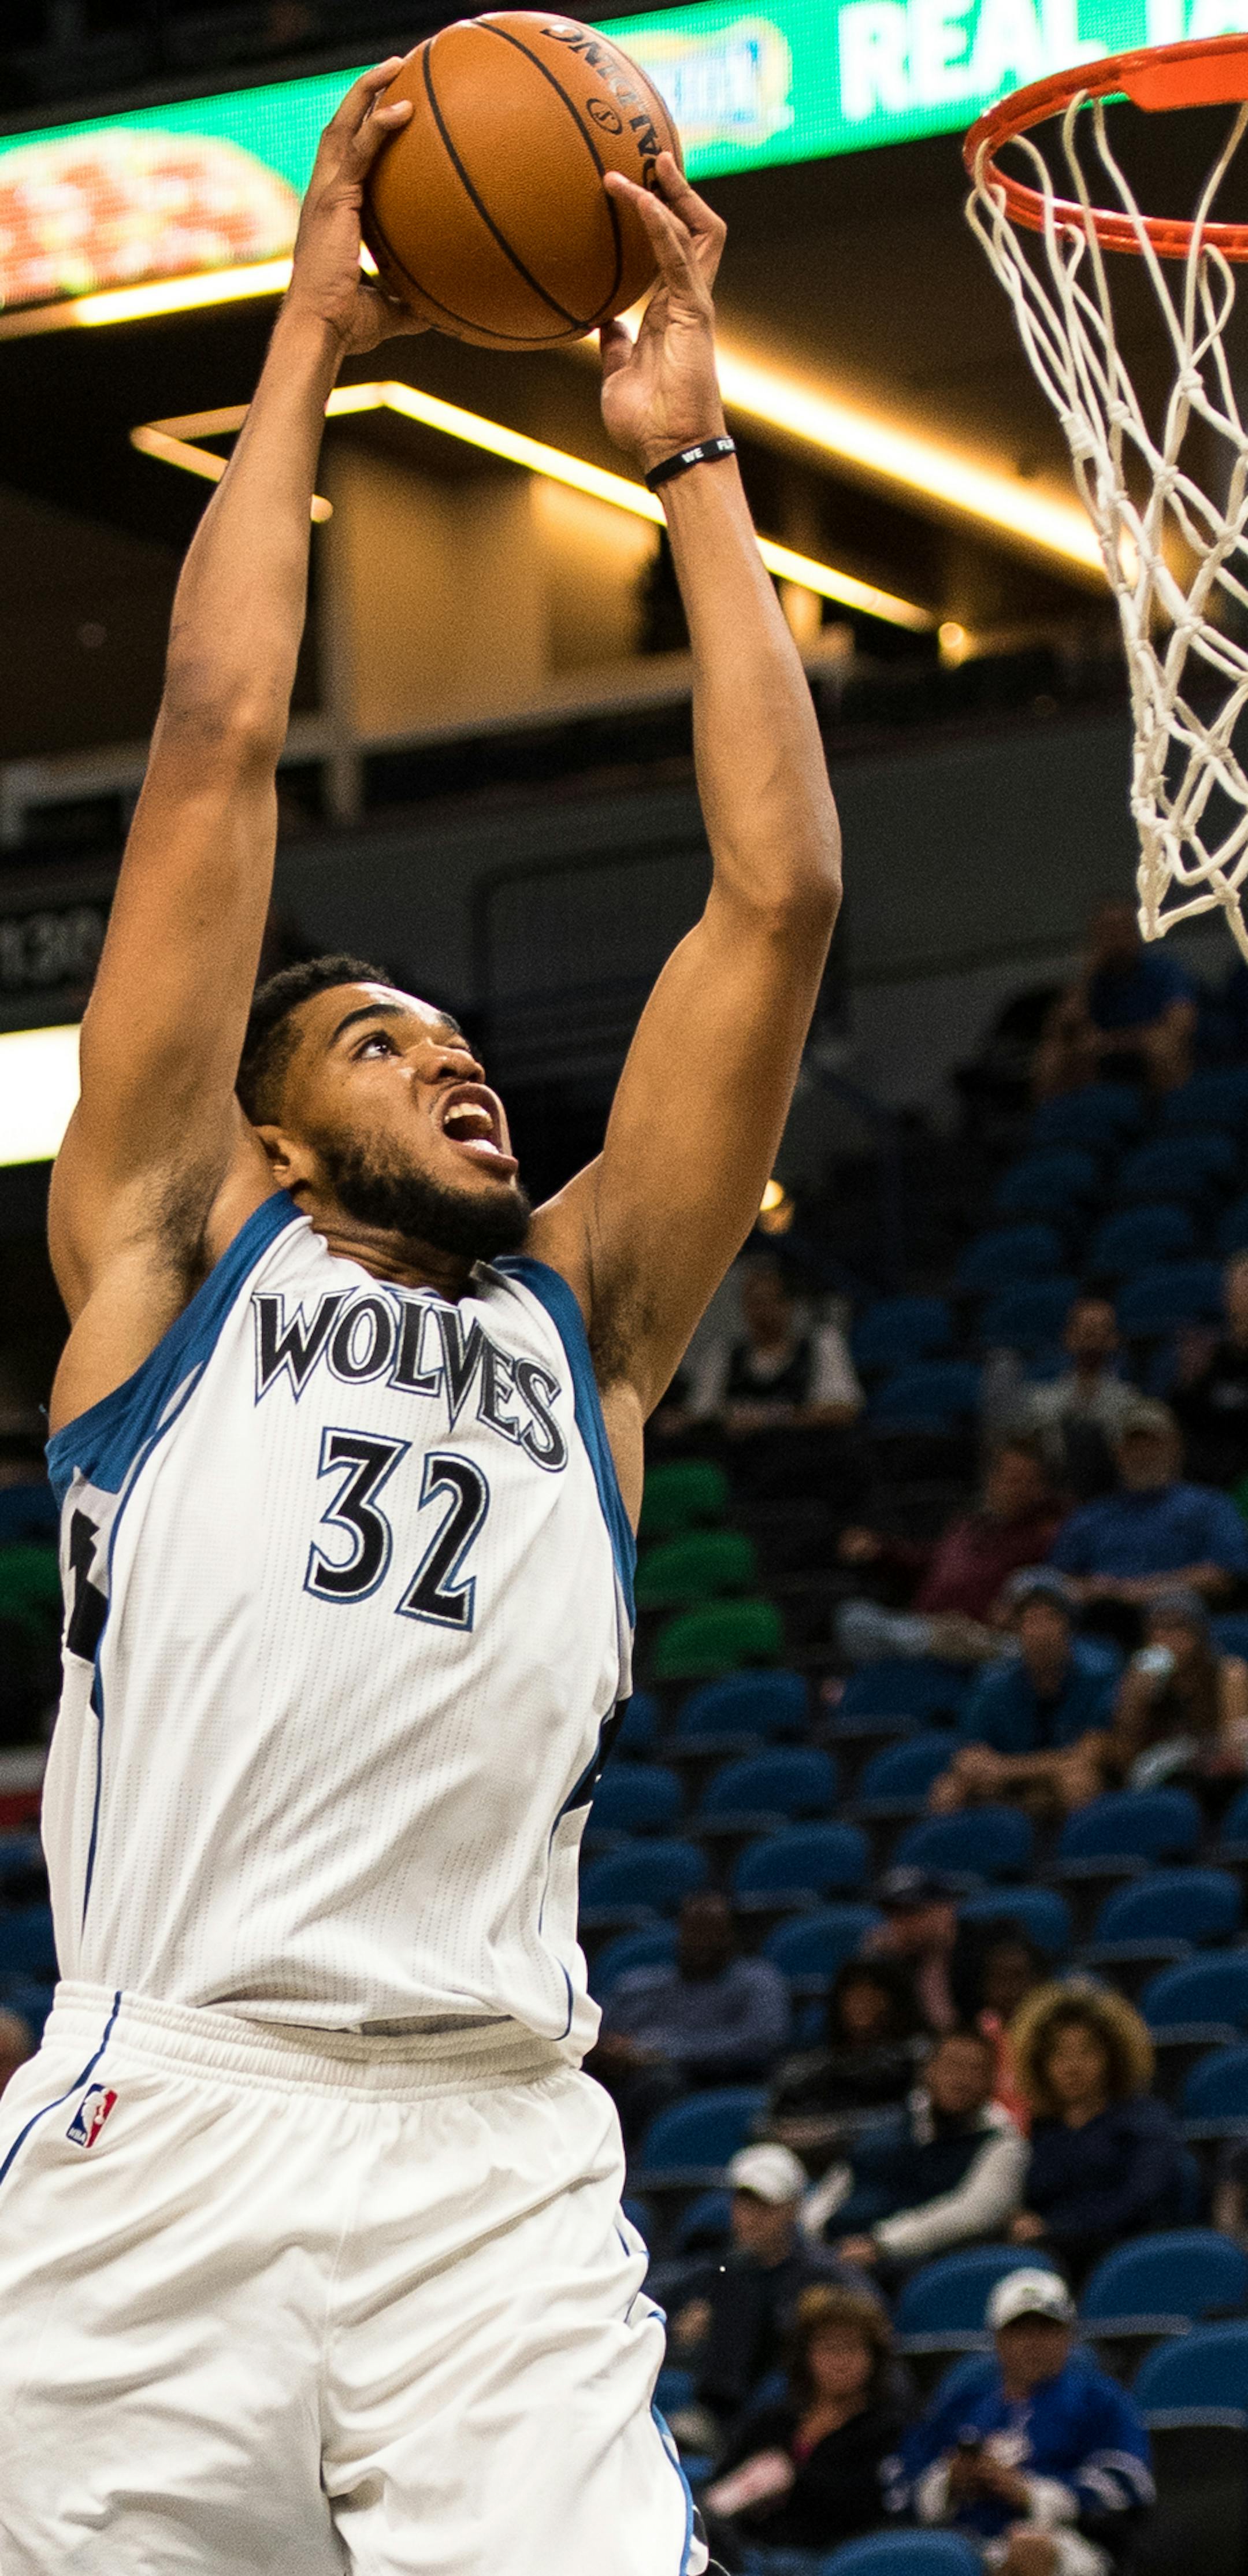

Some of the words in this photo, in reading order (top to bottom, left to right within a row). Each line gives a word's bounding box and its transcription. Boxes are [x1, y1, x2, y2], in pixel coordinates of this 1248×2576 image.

[540, 23, 663, 192] PALDING
[836, 0, 1107, 123] REAL
[681, 447, 704, 463] WE
[250, 1284, 569, 1473] WOLVES
[303, 1426, 491, 1633] 32
[68, 2126, 87, 2143] NBA
